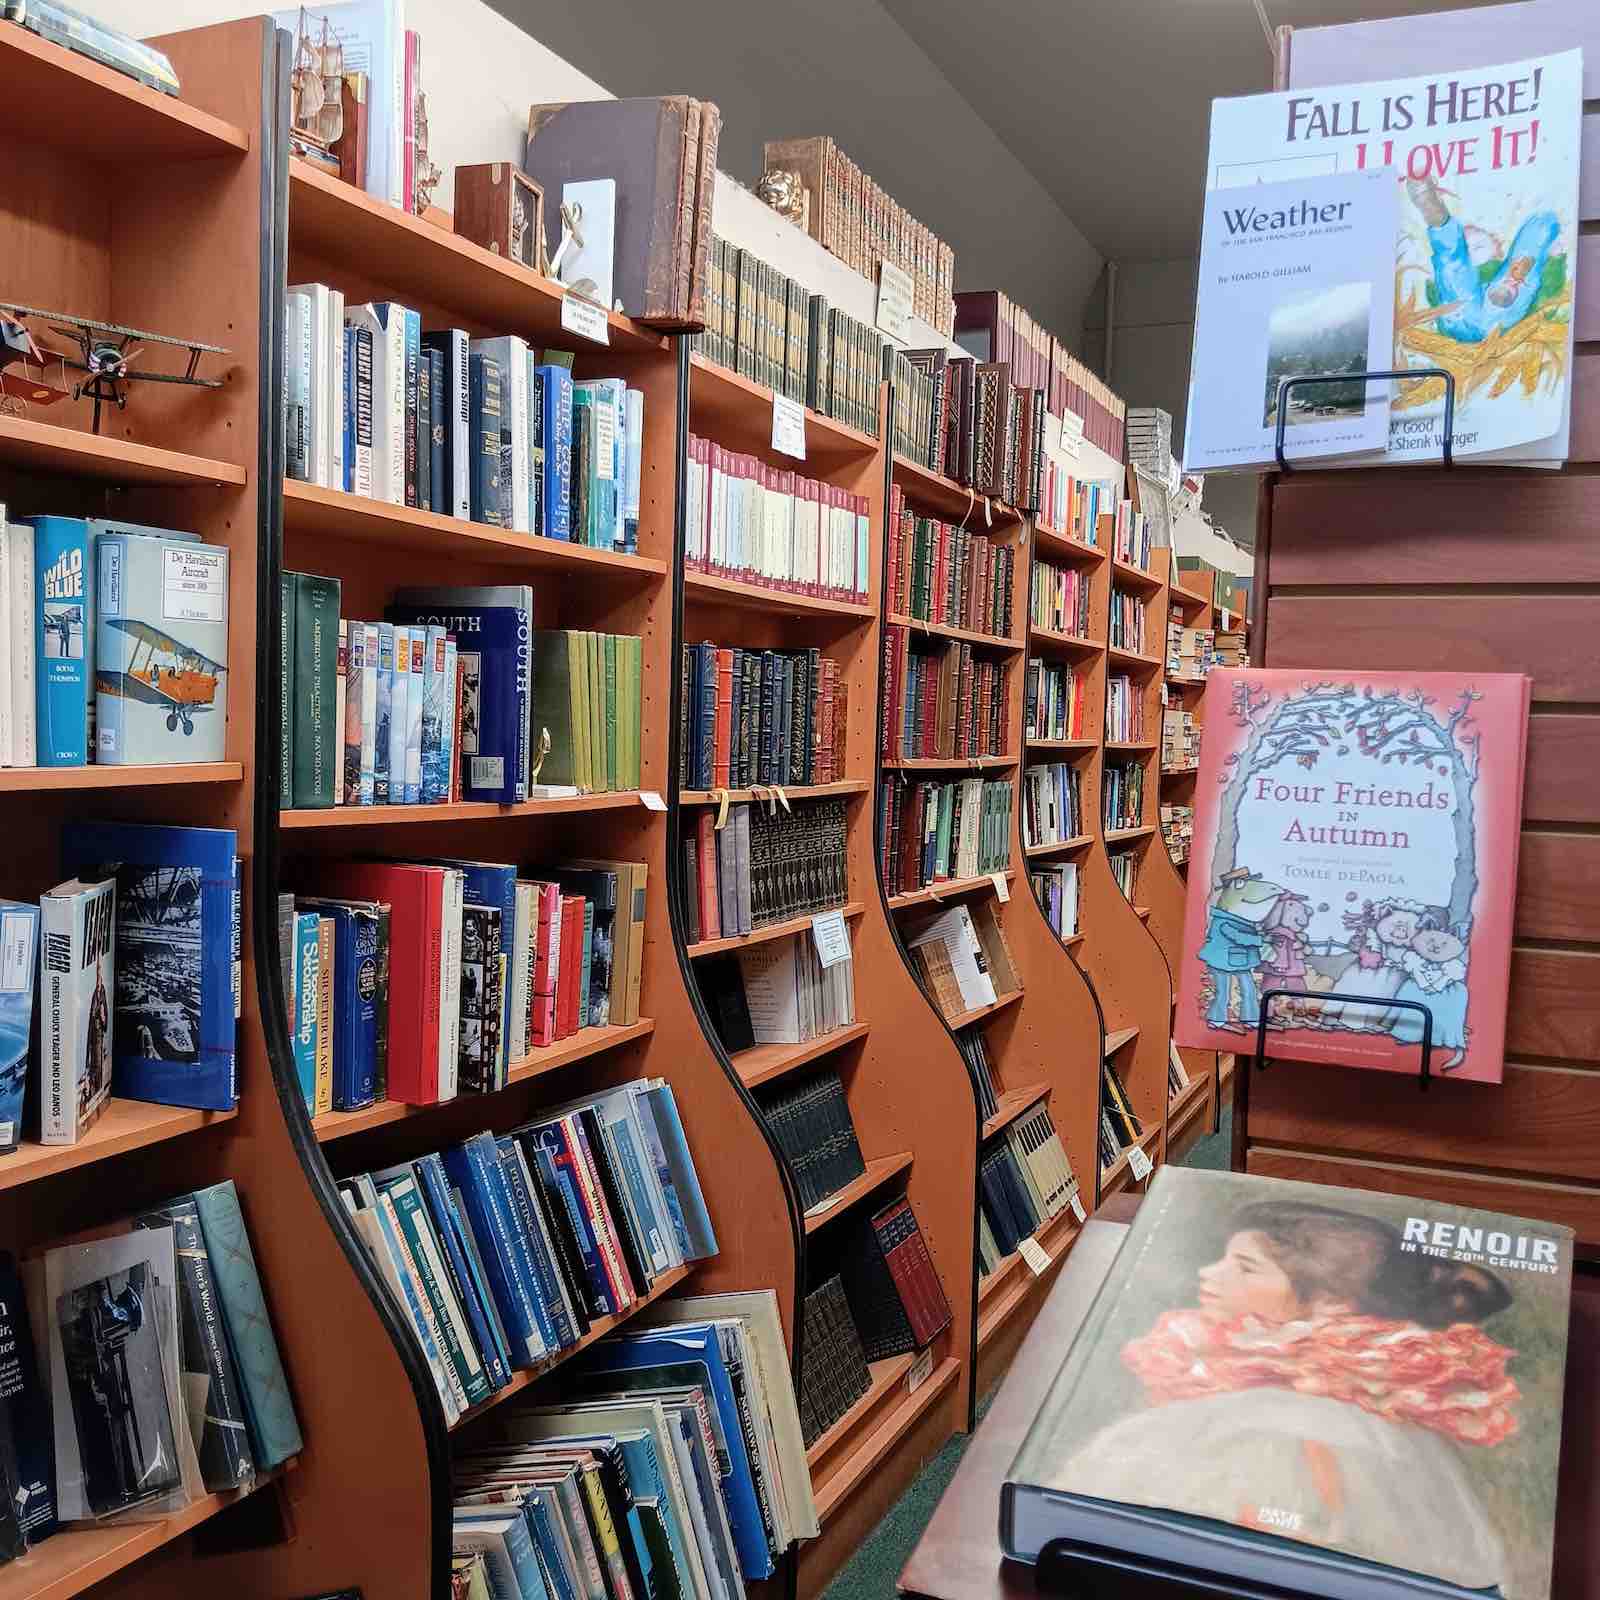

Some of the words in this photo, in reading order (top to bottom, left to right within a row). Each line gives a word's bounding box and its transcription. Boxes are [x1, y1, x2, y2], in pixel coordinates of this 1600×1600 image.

[1286, 97, 1371, 142] FALL
[1382, 94, 1414, 132] IS
[1426, 67, 1544, 127] HERE!
[1490, 119, 1541, 171] IT!
[1223, 200, 1352, 235] Weather
[1231, 269, 1270, 282] HAROLD
[1273, 264, 1312, 277] GILLIAM
[409, 339, 417, 385] HARM'S
[460, 337, 469, 391] Abandon
[358, 381, 371, 443] SHACKLETON
[409, 387, 417, 411] WAY
[1396, 433, 1434, 448] Shenk
[1434, 431, 1479, 449] Wnger
[1403, 420, 1434, 433] Good
[358, 448, 371, 490] SOUTH
[560, 445, 571, 502] GOLD
[44, 549, 83, 585] WILD
[171, 551, 184, 563] De
[45, 571, 83, 599] BLUE
[281, 610, 289, 666] AMERICAN
[313, 617, 321, 672] AMERICAN
[416, 616, 481, 632] SOUTH
[516, 609, 529, 693] SOUTH
[281, 670, 289, 728] PRACTICAL
[313, 676, 321, 732] PRACTICAL
[281, 734, 289, 796] NAVIGATOR
[313, 736, 321, 795] NAVIGATOR
[1255, 777, 1325, 804] Four
[1333, 781, 1449, 809] Friends
[1283, 817, 1411, 849] Autumn
[1338, 811, 1359, 822] IN
[45, 932, 71, 974] YEAGER
[489, 926, 499, 977] BOREAL
[51, 976, 60, 1008] GENERAL
[298, 942, 317, 1044] Seamanship
[489, 983, 497, 1011] TIES
[51, 1009, 60, 1033] CHUCK
[51, 1034, 60, 1061] YEAGER
[318, 1034, 328, 1080] BLAKE
[51, 1062, 60, 1077] AND
[51, 1079, 60, 1092] LEO
[51, 1093, 60, 1116] JANOS
[508, 1166, 537, 1235] PILOTING
[1400, 1242, 1417, 1252] IN
[1421, 1245, 1449, 1258] THE
[1452, 1250, 1485, 1262] 20TH
[1488, 1257, 1560, 1274] CENTURY
[1403, 1218, 1559, 1264] RENOIR
[199, 1288, 216, 1321] World
[212, 1349, 226, 1377] Gilbert
[429, 1318, 463, 1393] Swinglehurst
[737, 1396, 761, 1472] NORTHWEST
